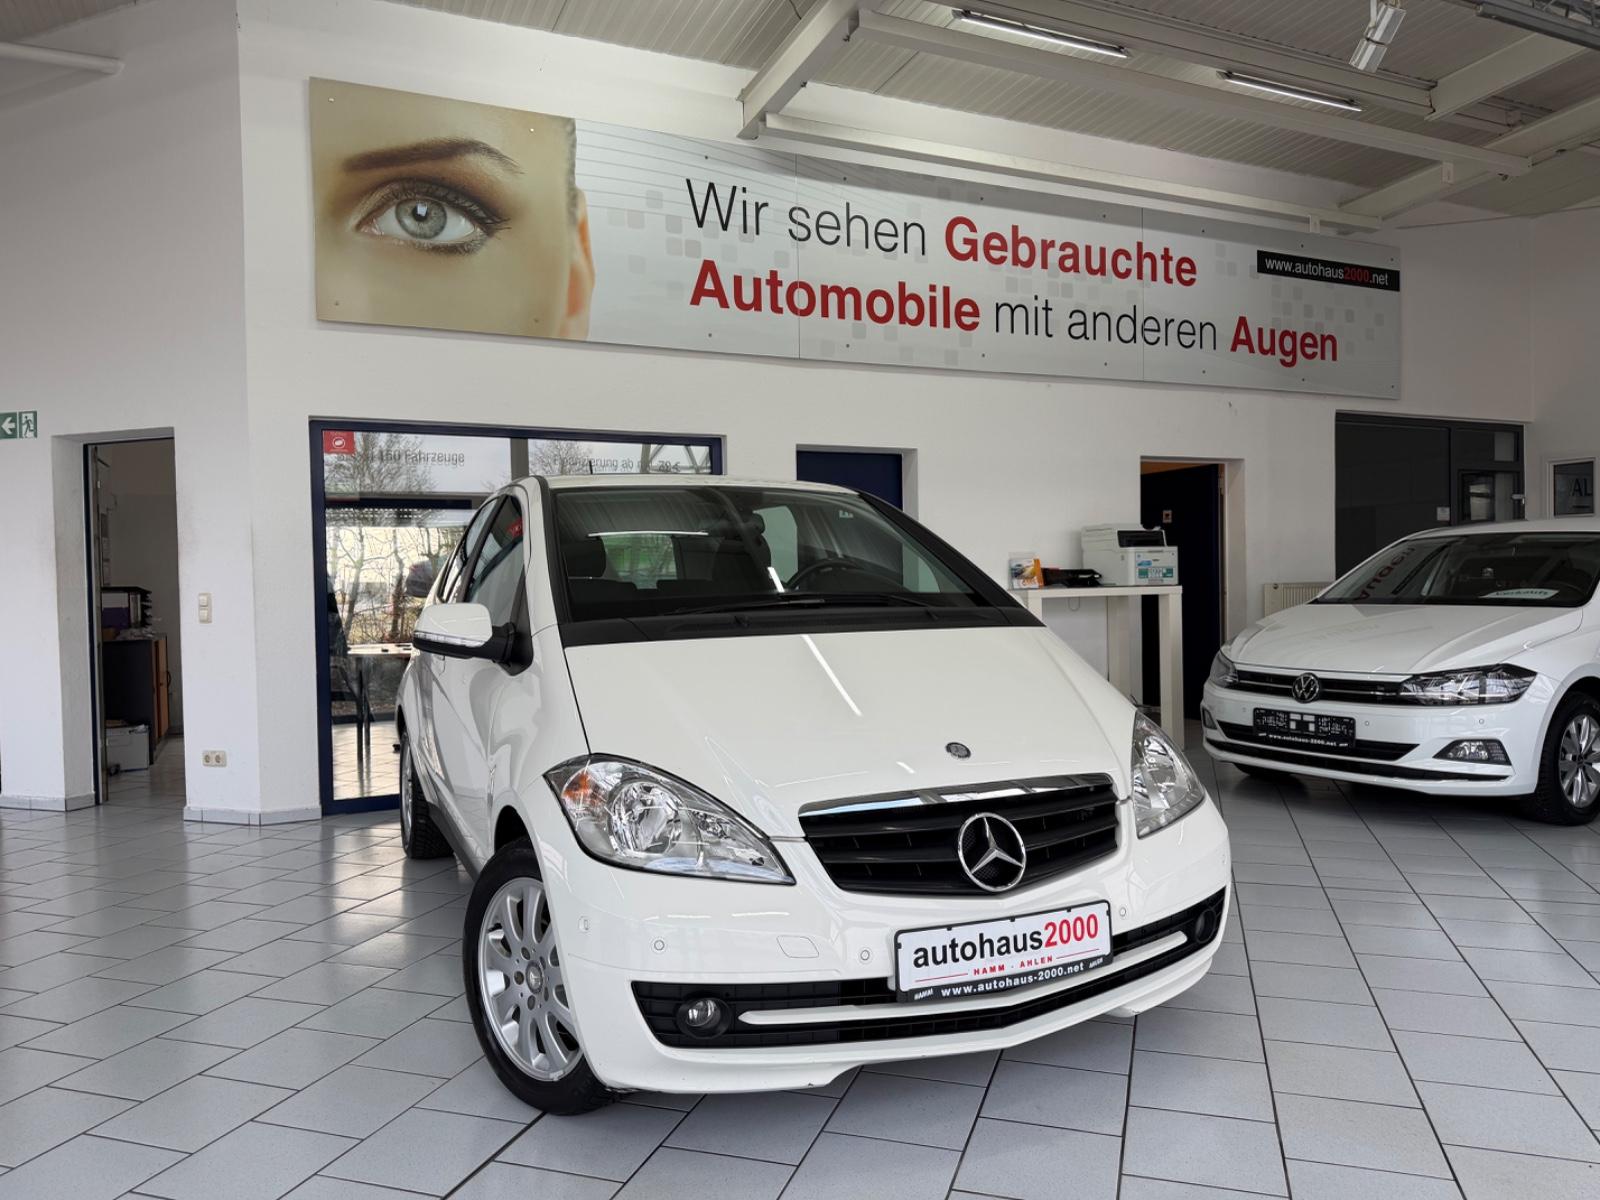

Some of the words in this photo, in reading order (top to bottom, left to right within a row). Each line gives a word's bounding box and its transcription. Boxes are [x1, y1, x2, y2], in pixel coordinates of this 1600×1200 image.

[686, 178, 769, 236] Wir
[788, 202, 926, 256] sehen
[945, 216, 1198, 287] Gebrauchte
[1264, 257, 1389, 286] www.autohaus2000.net
[690, 259, 981, 331] Automobile
[995, 295, 1054, 338] mit
[1067, 305, 1217, 351] anderen
[1231, 316, 1338, 368] Augen
[405, 449, 465, 467] Fahrzeuge
[913, 913, 1099, 968] autohaus2000
[941, 964, 1085, 998] www.autohaus-2000.net
[973, 964, 1006, 976] HAMM
[1020, 955, 1054, 968] AHLEN
